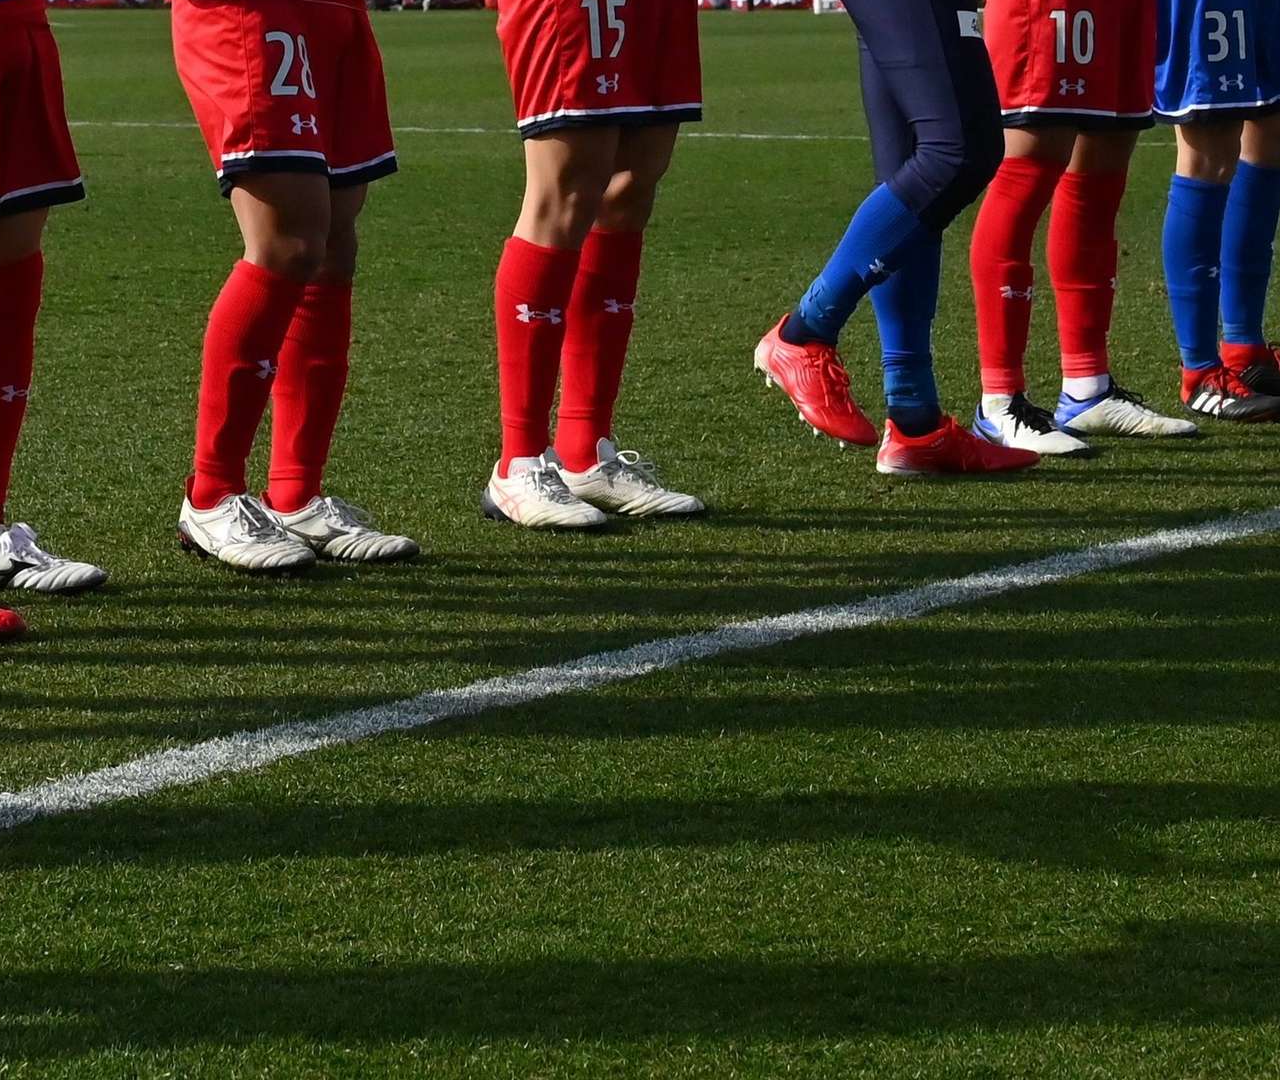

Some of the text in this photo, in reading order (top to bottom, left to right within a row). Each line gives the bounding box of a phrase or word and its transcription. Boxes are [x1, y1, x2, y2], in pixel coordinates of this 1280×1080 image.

[1048, 9, 1095, 65] 10
[1204, 9, 1246, 62] 31
[265, 30, 317, 99] 28
